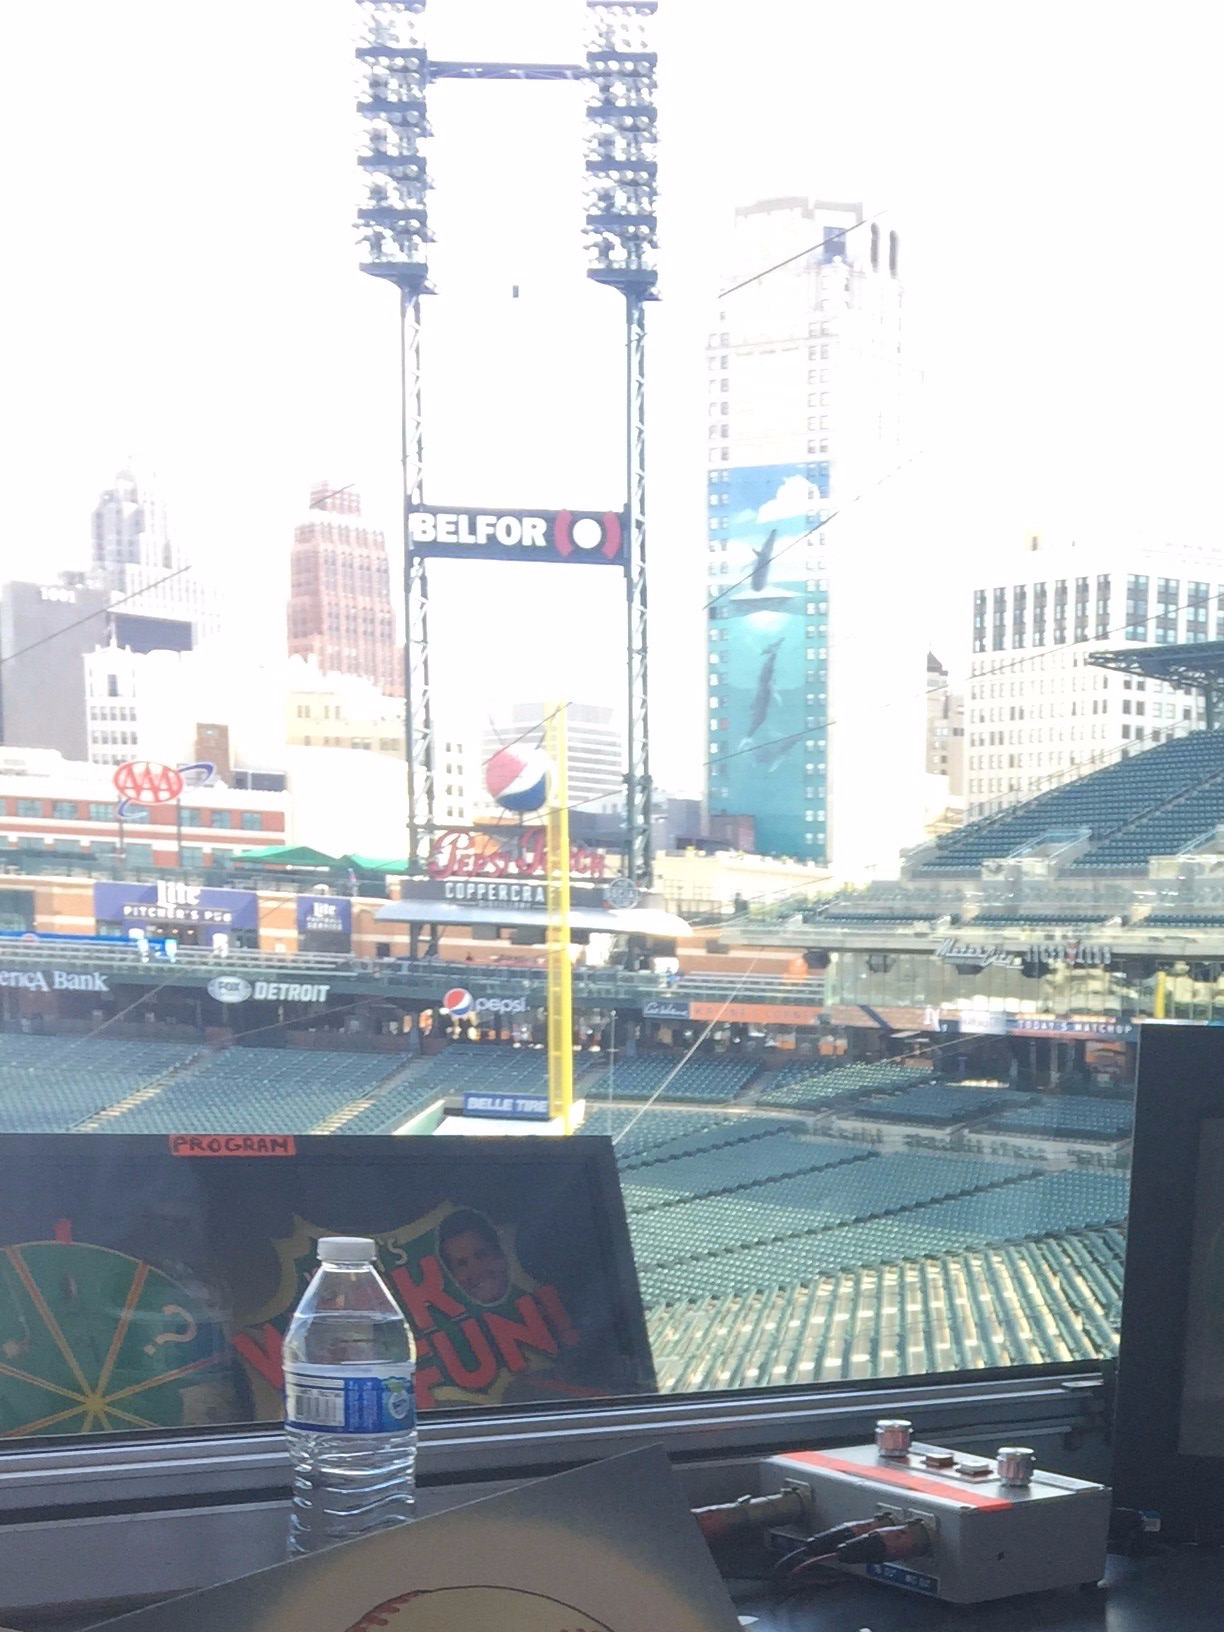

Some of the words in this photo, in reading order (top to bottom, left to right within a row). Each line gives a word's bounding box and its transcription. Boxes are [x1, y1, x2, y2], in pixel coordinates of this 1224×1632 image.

[408, 512, 548, 546] BELFOR
[118, 764, 182, 802] AAA
[157, 880, 200, 908] Lite
[123, 905, 199, 920] PITCHER'S
[204, 911, 232, 922] PUB
[313, 902, 337, 917] Lite
[53, 971, 110, 991] Bank
[218, 981, 240, 992] FOX
[253, 981, 330, 1002] DETROIT
[475, 996, 527, 1014] pepsi
[1018, 1020, 1068, 1031] TODAYS
[467, 1097, 513, 1115] BELLE
[516, 1098, 548, 1116] TIRE
[173, 1137, 288, 1153] PROGRAM
